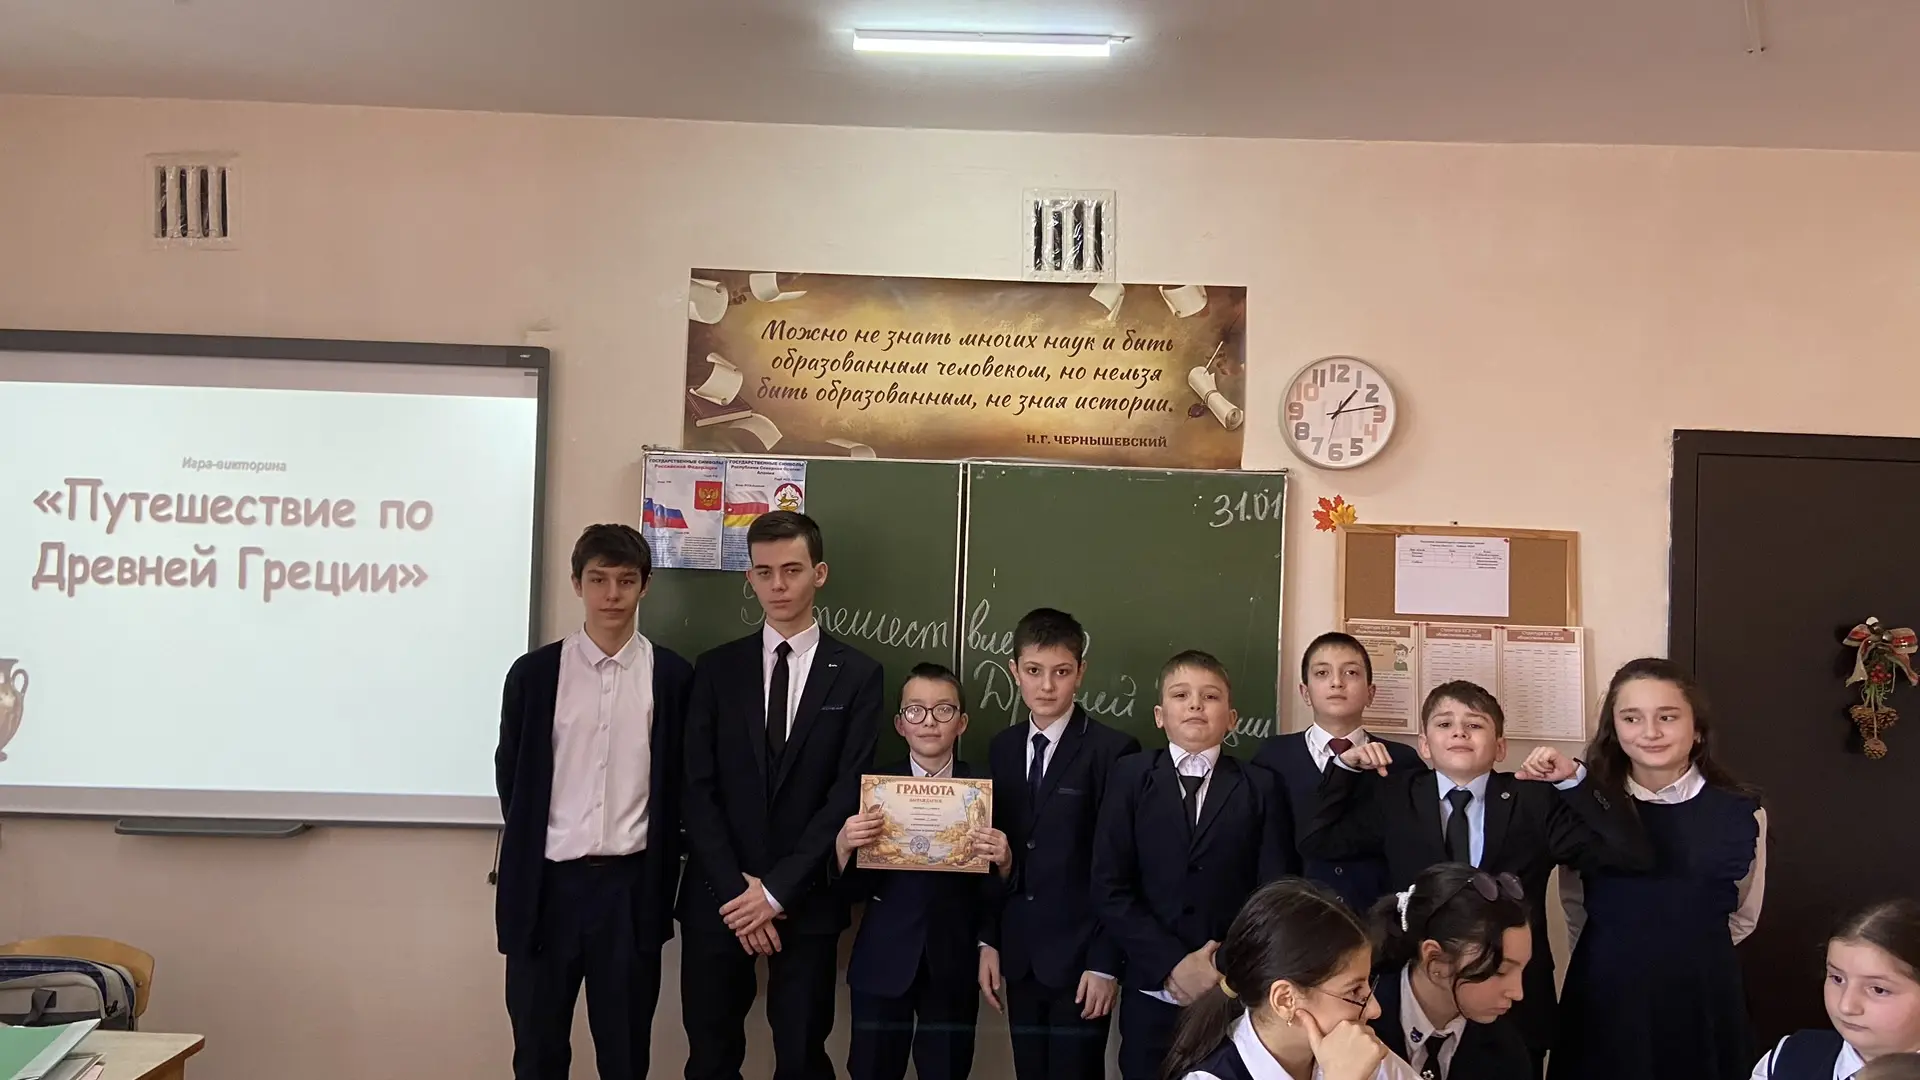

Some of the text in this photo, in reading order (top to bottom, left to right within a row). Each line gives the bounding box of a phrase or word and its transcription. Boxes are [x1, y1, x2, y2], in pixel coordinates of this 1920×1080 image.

[761, 319, 1174, 358] Можно не знать многих наук и быть
[771, 348, 1163, 390] образованным человеком, но нельзя
[1312, 369, 1326, 388] 11
[1329, 364, 1350, 383] 12
[1356, 370, 1362, 389] 1
[757, 376, 1174, 420] быть образованным, не зная истории.
[1294, 382, 1320, 402] 10
[1365, 384, 1380, 403] 2
[1288, 402, 1304, 421] 9
[1372, 405, 1387, 423] 3
[1294, 422, 1310, 440] 8
[1363, 424, 1378, 442] 4
[1026, 434, 1168, 448] Н.Г. ЧЕРНЫШЕВСКИЙ
[1311, 437, 1325, 456] 7
[1350, 438, 1364, 457] 5
[1327, 443, 1344, 462] 6
[182, 456, 287, 474] Игра-викторина
[32, 477, 434, 535] «Путешествие по
[1209, 490, 1282, 528] 31.01
[31, 541, 429, 603] Древней Греции»
[896, 783, 956, 796] ГРАМОТА
